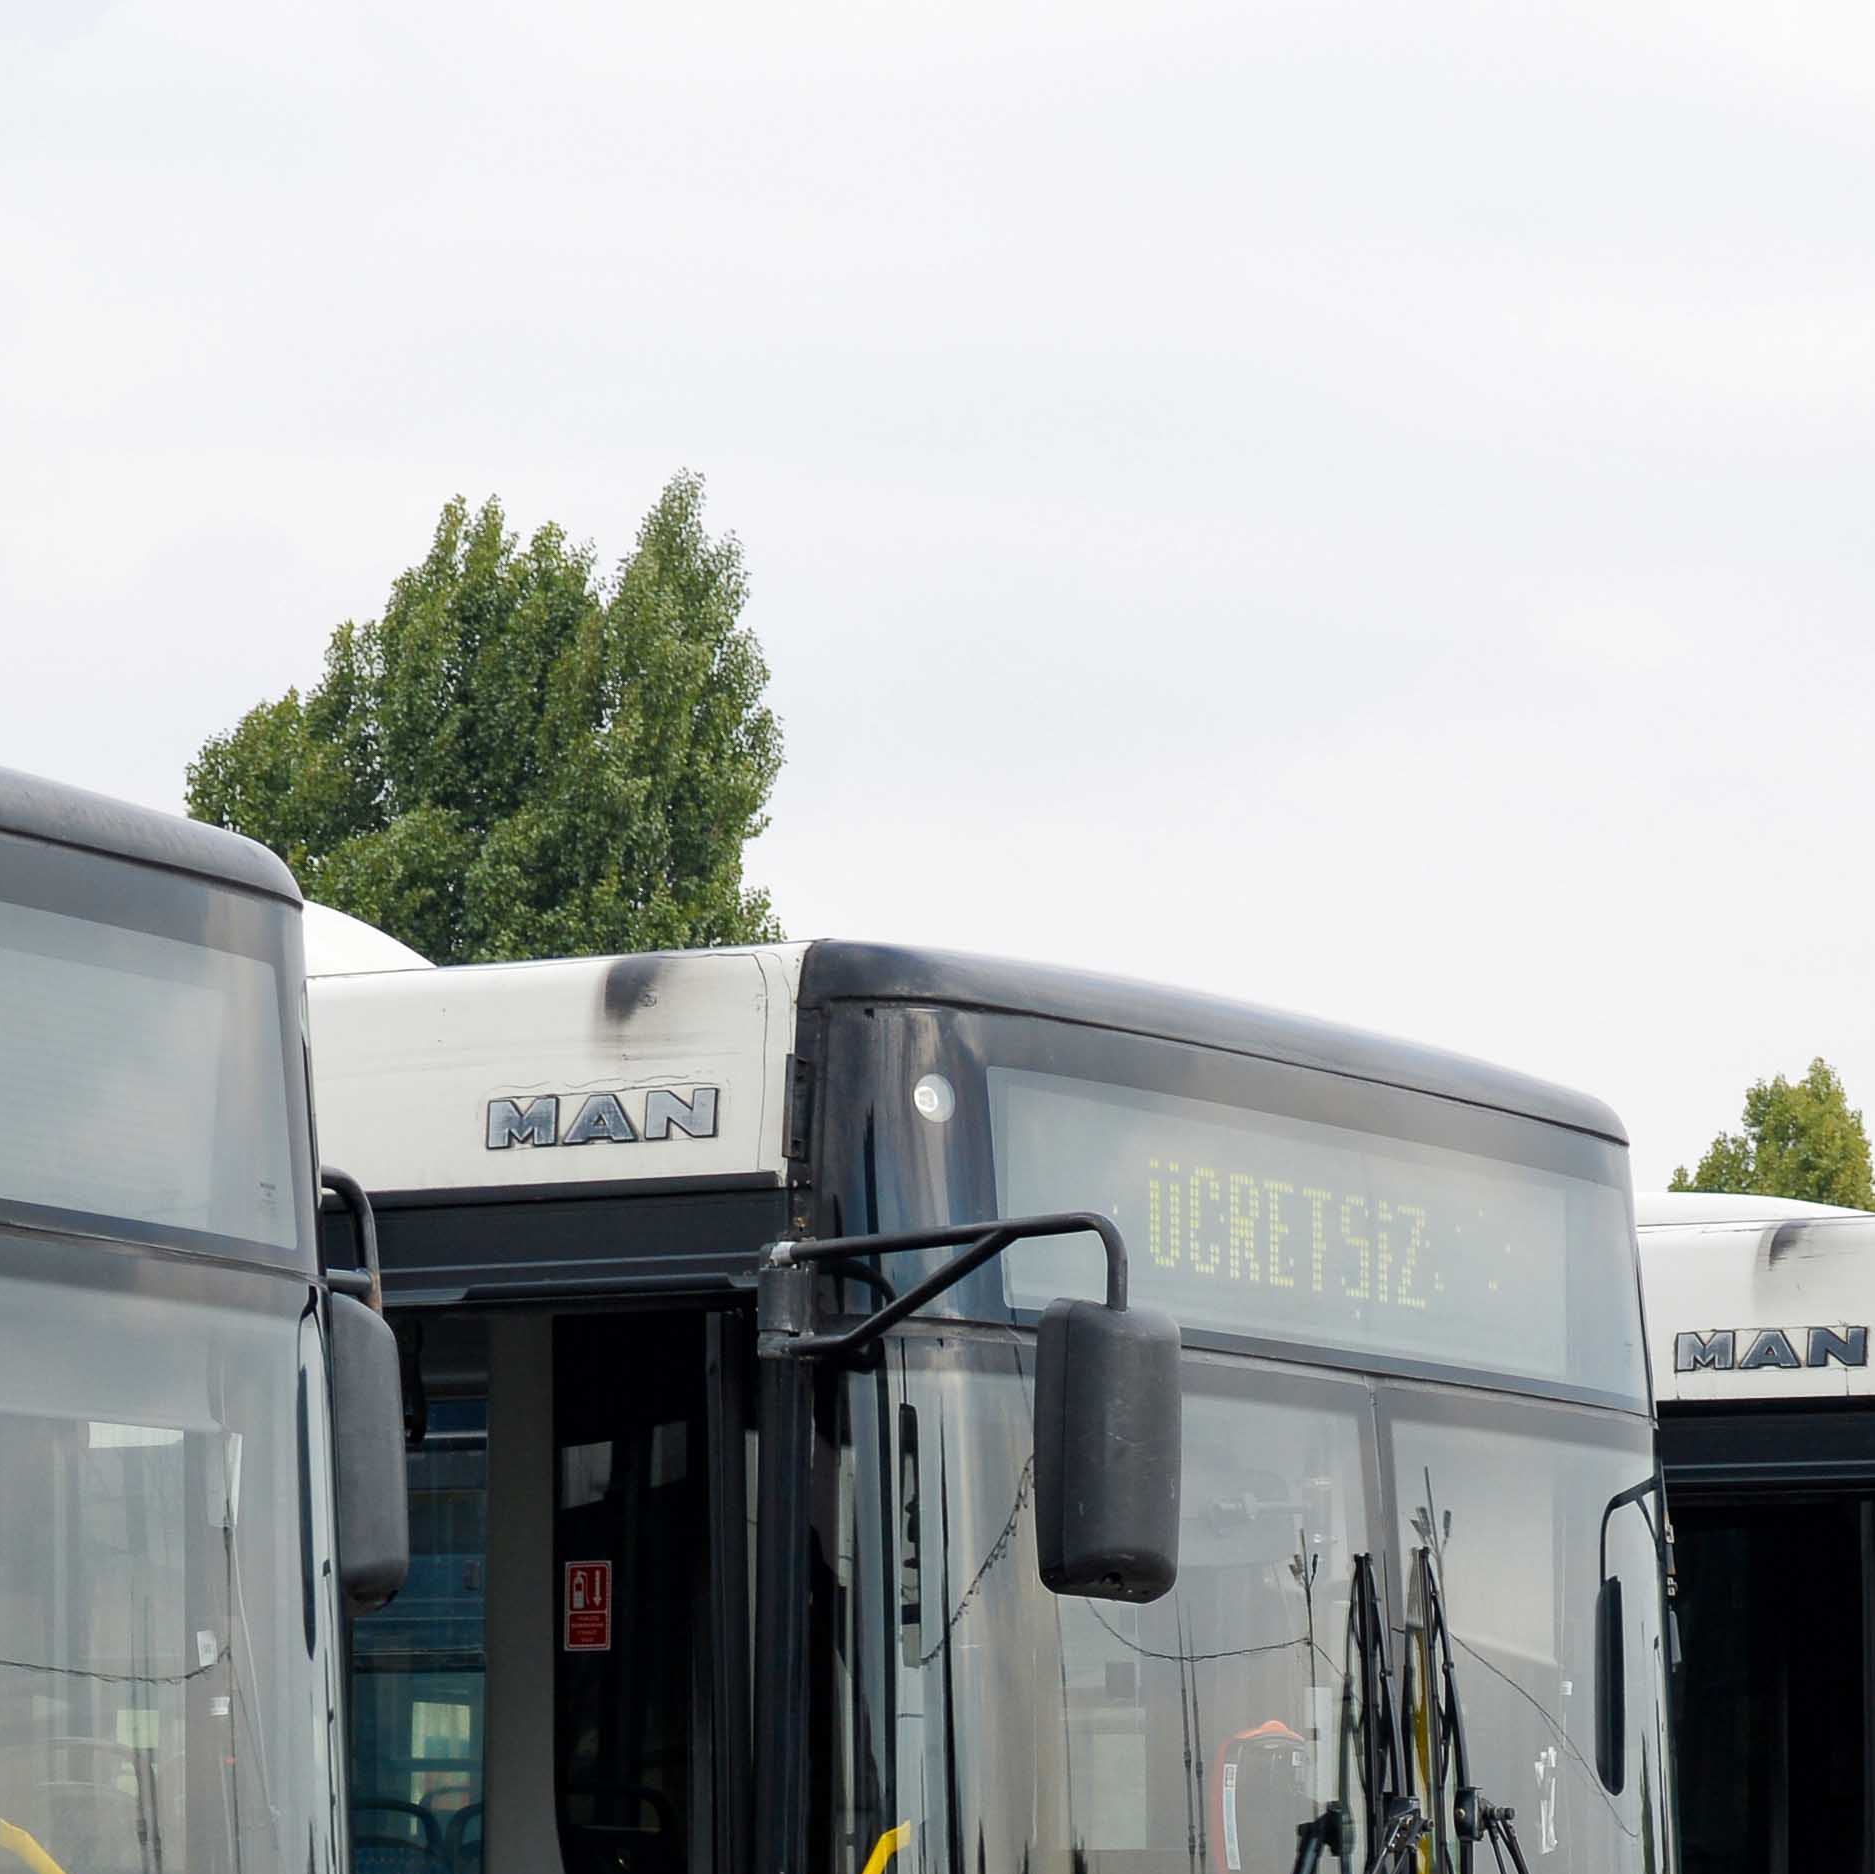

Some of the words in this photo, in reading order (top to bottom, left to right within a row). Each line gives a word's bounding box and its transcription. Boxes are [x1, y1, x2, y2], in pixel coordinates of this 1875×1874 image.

[486, 1086, 719, 1150] MAN
[1148, 1159, 1426, 1310] ÜCRETSİZ
[1674, 1325, 1868, 1372] MAN
